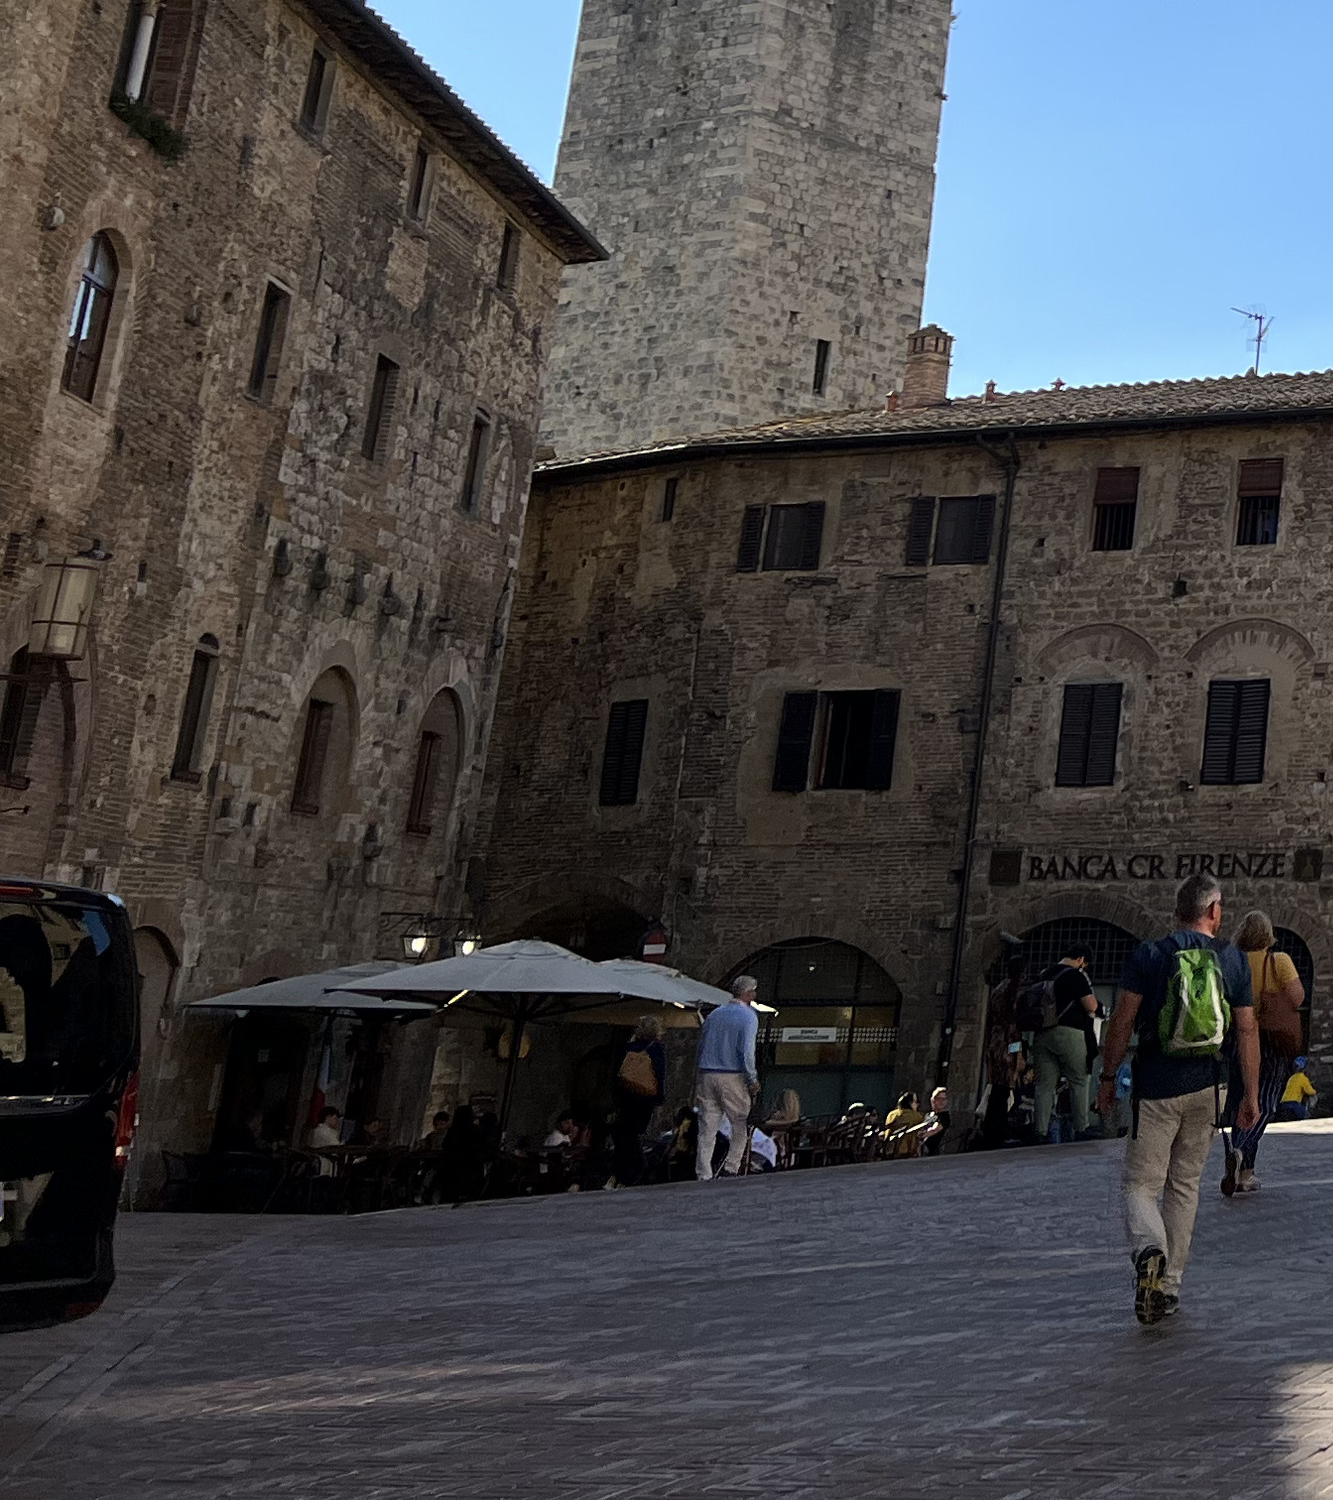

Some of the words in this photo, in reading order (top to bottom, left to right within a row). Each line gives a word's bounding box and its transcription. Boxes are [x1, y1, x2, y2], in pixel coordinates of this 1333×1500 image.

[1028, 854, 1119, 881] BANCA
[1127, 854, 1165, 880] CR
[1174, 853, 1287, 879] FIRENZE
